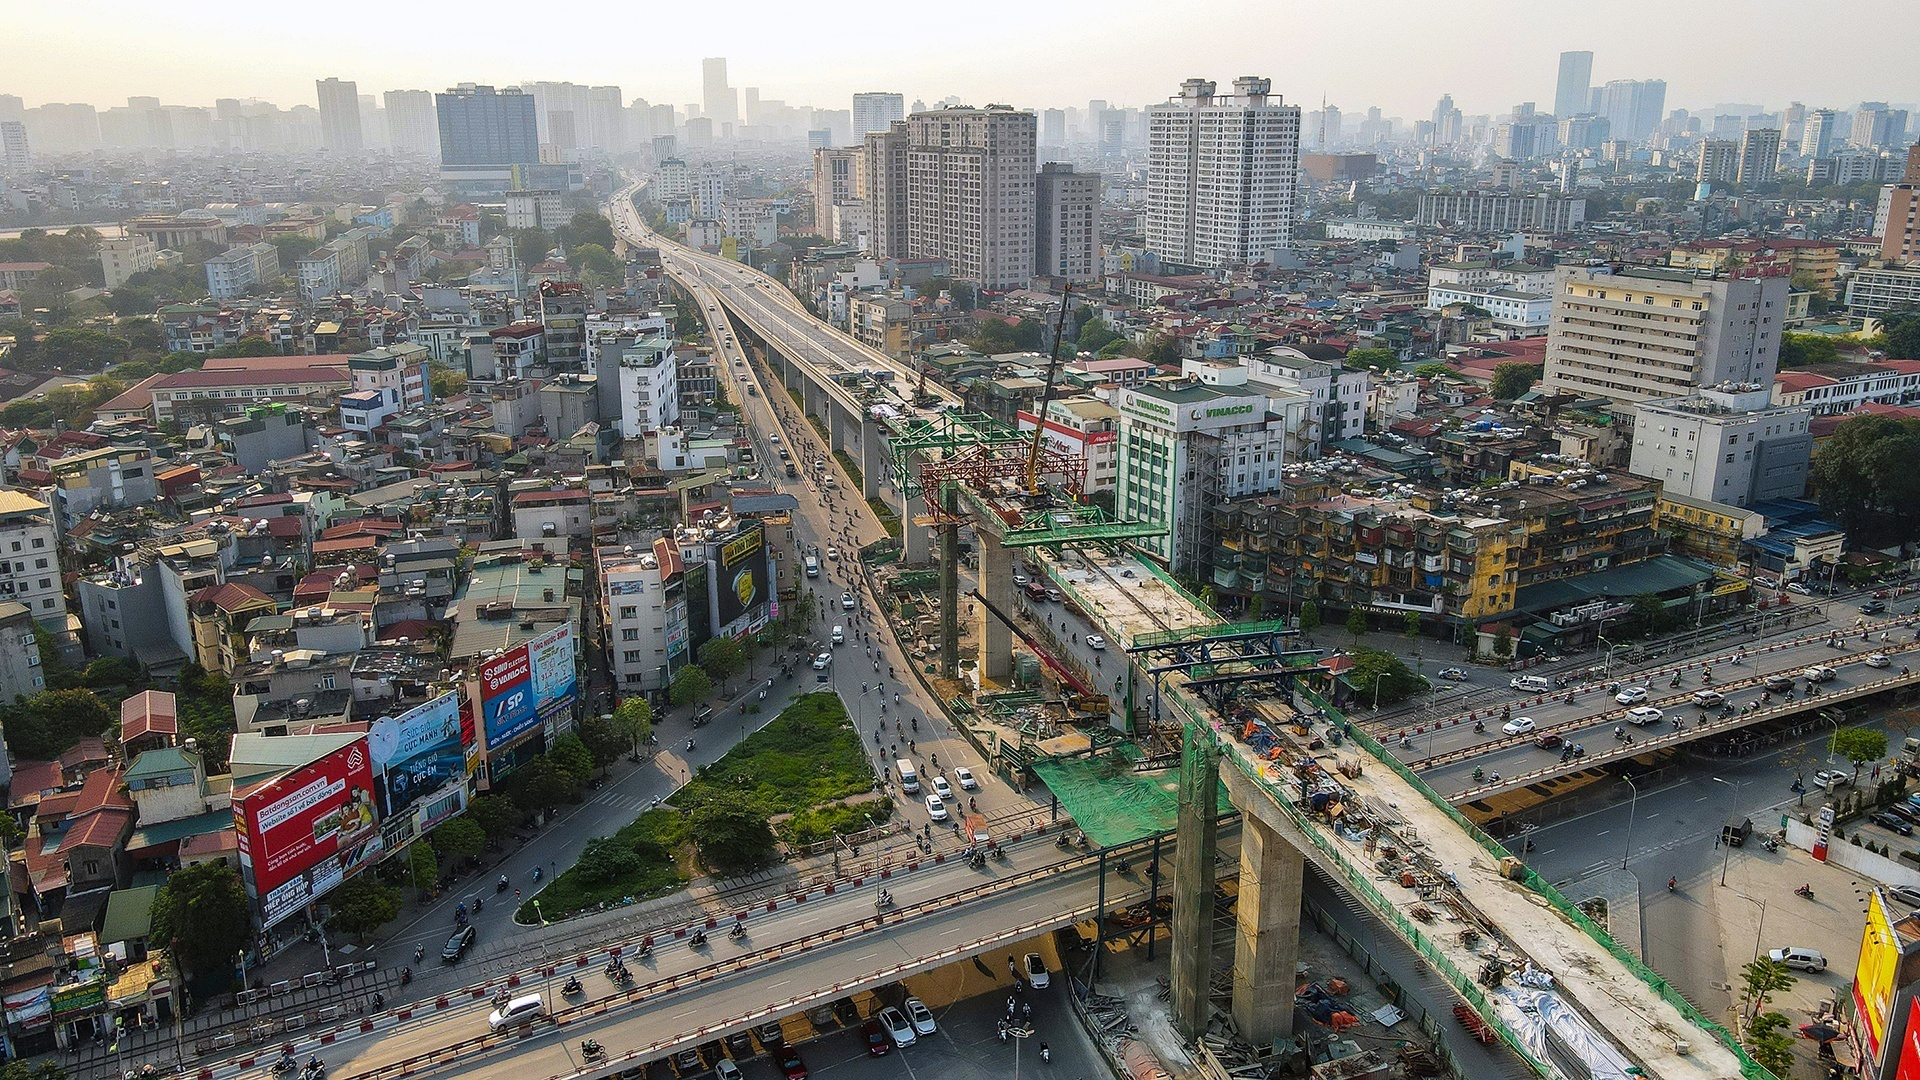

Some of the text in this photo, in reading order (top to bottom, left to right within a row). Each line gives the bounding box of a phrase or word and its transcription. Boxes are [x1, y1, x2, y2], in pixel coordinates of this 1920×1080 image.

[1136, 399, 1170, 416] VINACCO
[1206, 404, 1253, 418] VINACCO
[493, 655, 527, 676] SINO ELECTRIC
[499, 664, 528, 685] VANLOCK
[507, 691, 524, 711] SP
[260, 780, 325, 819] Batdongsan.com.vn
[262, 812, 286, 830] Website
